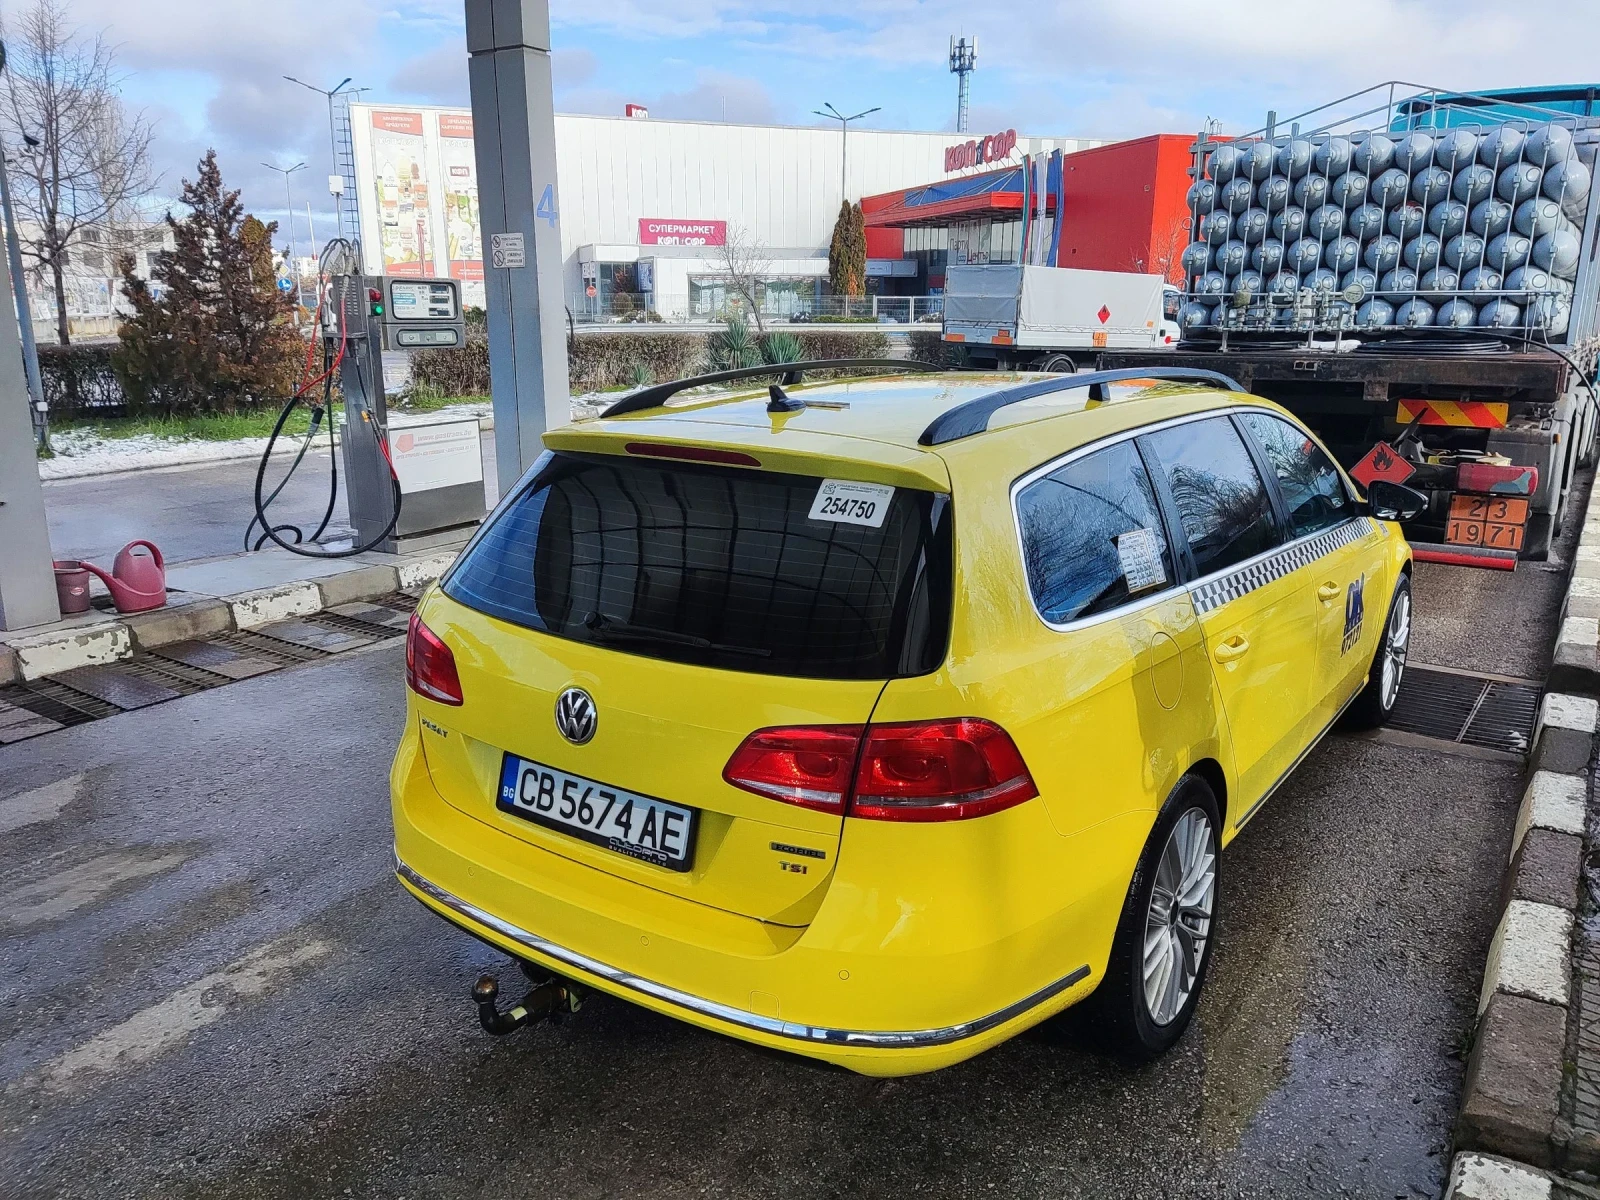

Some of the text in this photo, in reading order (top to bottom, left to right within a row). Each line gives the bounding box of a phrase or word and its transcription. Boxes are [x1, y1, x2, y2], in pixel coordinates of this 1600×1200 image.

[945, 140, 976, 172] КОП
[984, 129, 1016, 163] СОР
[537, 184, 557, 228] 4
[648, 224, 715, 235] СУПЕРМАРКЕТ
[657, 236, 679, 246] КОП
[685, 236, 706, 246] СОР
[820, 496, 876, 519] 254750
[502, 785, 515, 799] BG
[778, 860, 808, 874] TSI
